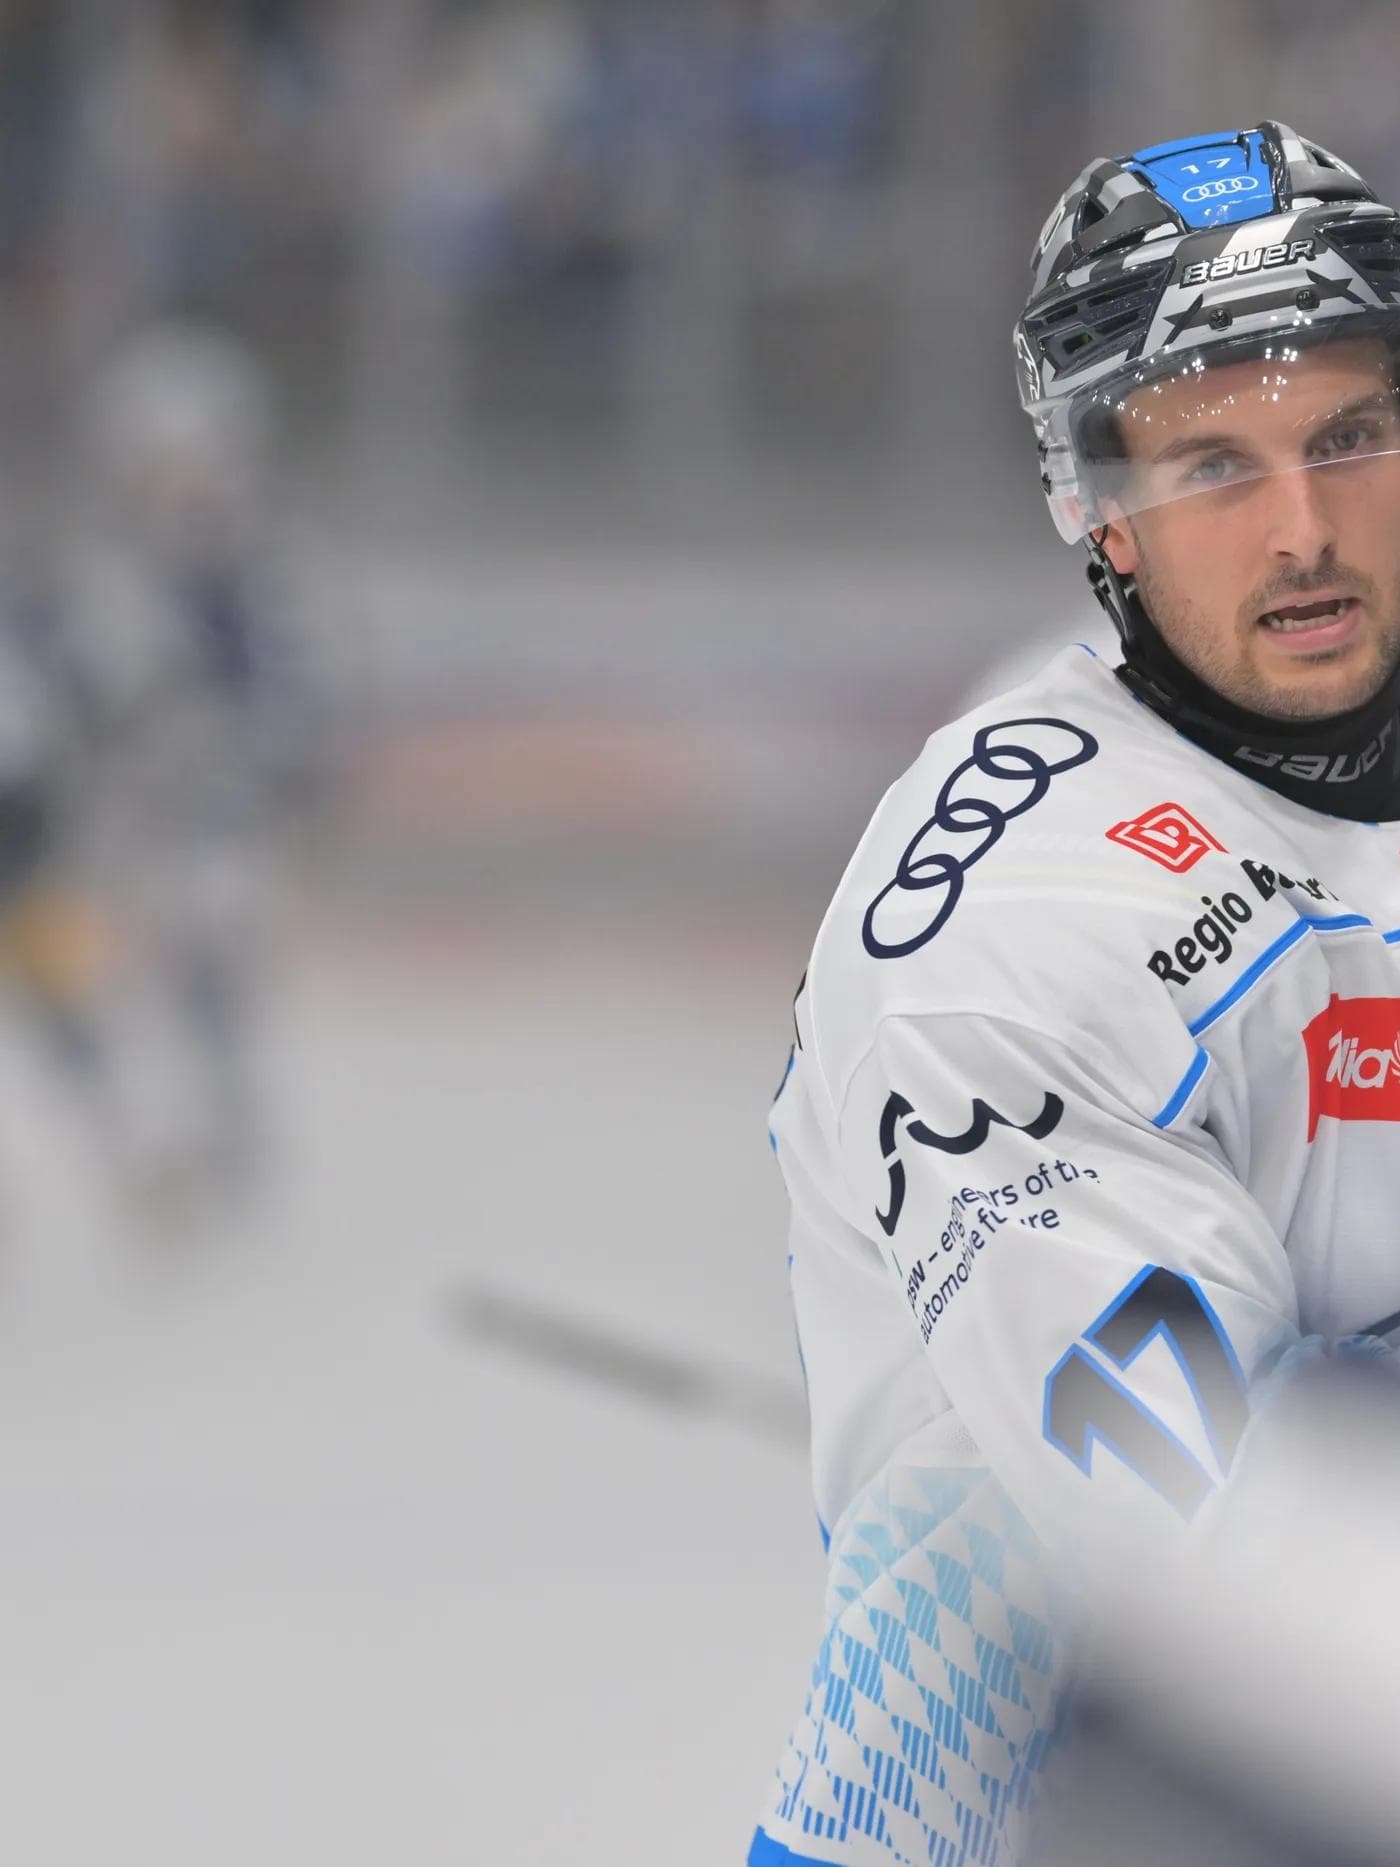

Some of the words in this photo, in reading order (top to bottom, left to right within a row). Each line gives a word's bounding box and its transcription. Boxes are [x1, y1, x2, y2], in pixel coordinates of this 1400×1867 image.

[1180, 239, 1317, 287] BAUER
[1147, 892, 1253, 986] Regio
[1025, 1162, 1054, 1197] of
[1041, 1262, 1250, 1524] 17
